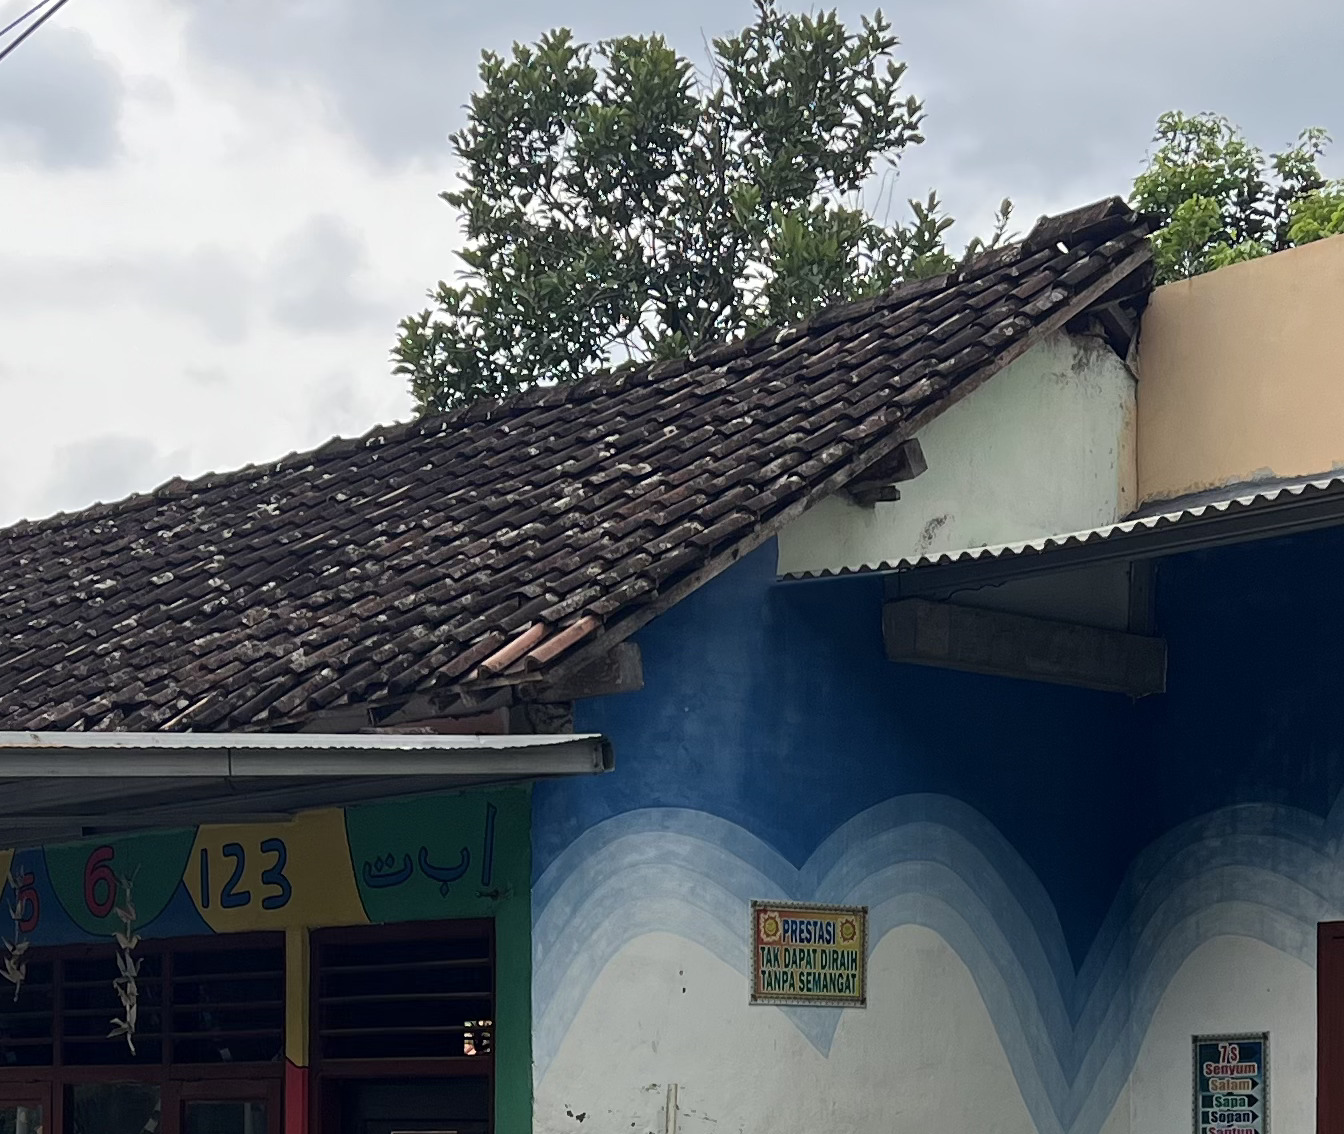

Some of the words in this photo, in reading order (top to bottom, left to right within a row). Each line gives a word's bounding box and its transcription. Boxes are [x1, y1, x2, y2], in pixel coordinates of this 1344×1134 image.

[83, 845, 116, 919] 6
[199, 838, 292, 910] 123
[782, 919, 836, 945] PRESTASI
[760, 946, 780, 969] TAK
[783, 947, 818, 969] DAPAT
[820, 949, 858, 972] DIRAIH
[760, 970, 795, 992] TANPA
[798, 972, 857, 994] SEMANGAT
[1205, 1063, 1256, 1076] Senyum
[1210, 1079, 1251, 1092] Salam
[1214, 1095, 1247, 1108] Sapa
[1210, 1111, 1251, 1125] Sopan
